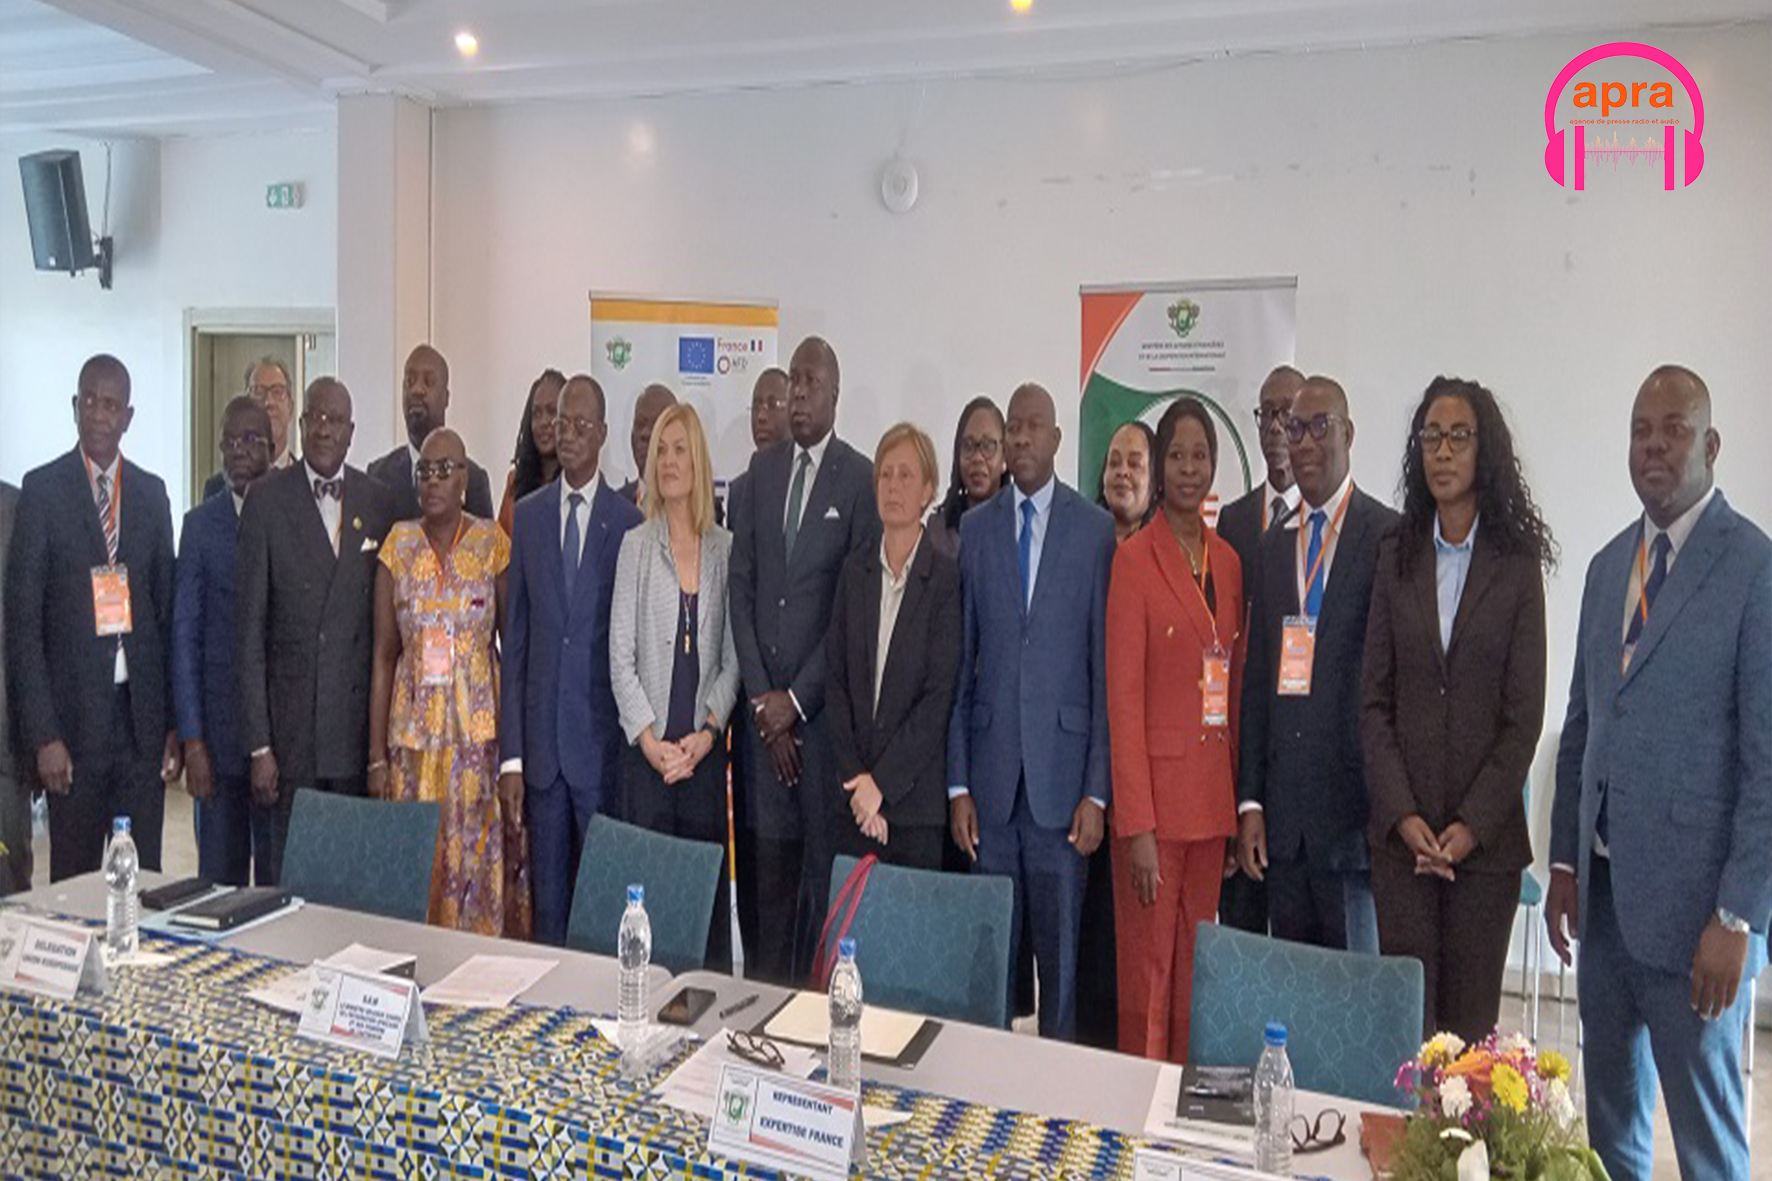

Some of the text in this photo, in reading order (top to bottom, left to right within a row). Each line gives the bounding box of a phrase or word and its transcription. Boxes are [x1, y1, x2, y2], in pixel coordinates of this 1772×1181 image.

[717, 337, 748, 353] France
[773, 1091, 833, 1115] REPRESENTANT
[808, 1127, 843, 1148] FRANCE
